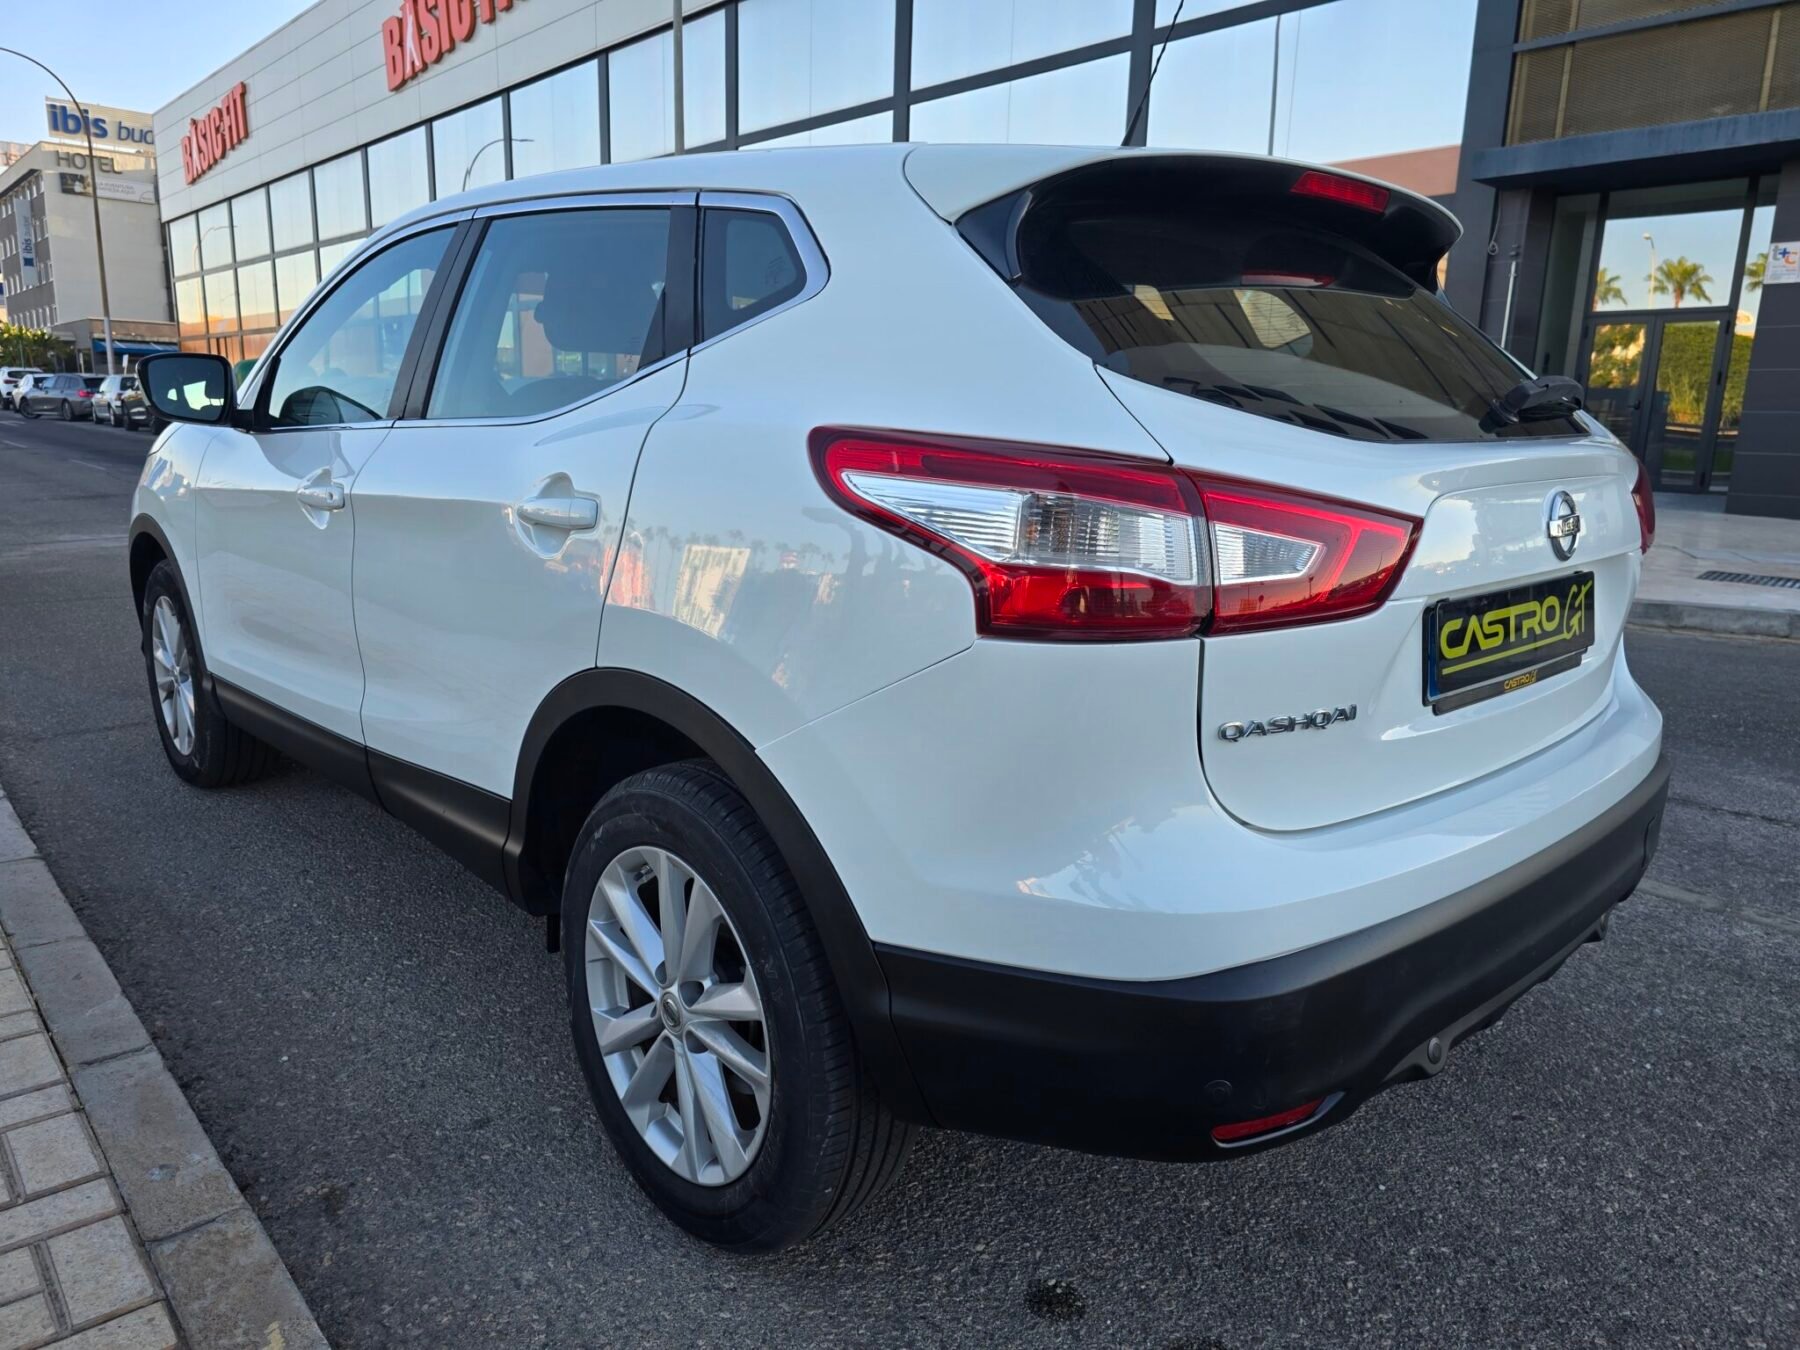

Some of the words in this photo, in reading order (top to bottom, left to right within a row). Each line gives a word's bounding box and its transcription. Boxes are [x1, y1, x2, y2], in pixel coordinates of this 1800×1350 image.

[48, 103, 108, 138] ibis
[56, 150, 123, 175] HOTEL
[1440, 595, 1560, 660] CASTRO
[1503, 674, 1530, 690] CASTRO
[1218, 704, 1357, 742] QASHQAI
